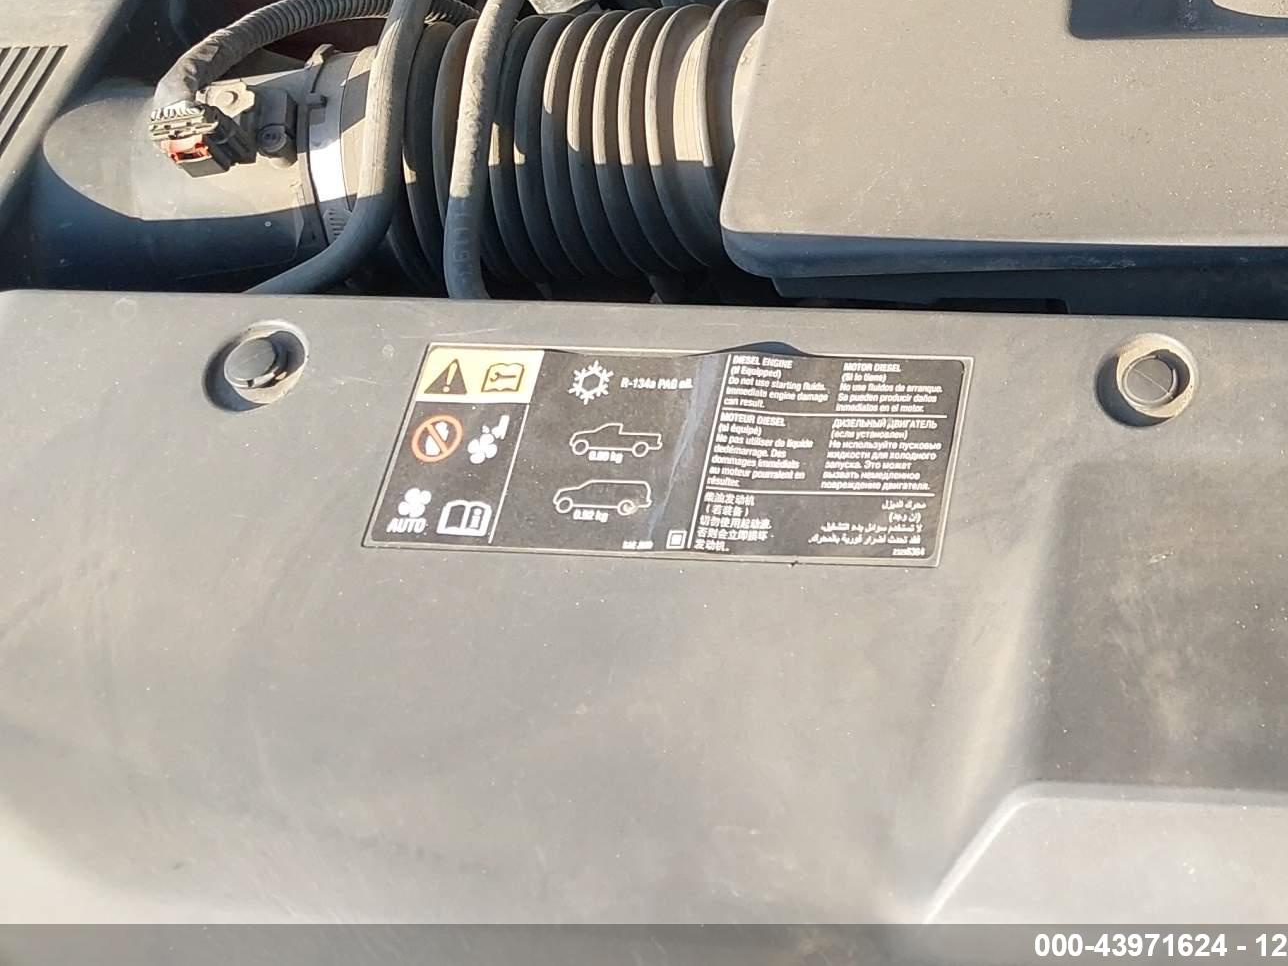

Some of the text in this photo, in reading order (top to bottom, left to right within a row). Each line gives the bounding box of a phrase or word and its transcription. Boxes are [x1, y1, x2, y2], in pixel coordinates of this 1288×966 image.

[733, 355, 793, 369] DIESEL ENGINE
[843, 362, 901, 372] MOTOR DIESEL
[741, 366, 782, 379] Equipped)
[620, 377, 656, 389] R-134a
[728, 376, 739, 384] Do
[771, 380, 801, 391] starting
[895, 383, 905, 392] de
[769, 391, 796, 401] engine
[797, 392, 828, 403] damage
[849, 394, 879, 403] pueden
[879, 394, 912, 403] producir
[720, 412, 786, 427] MOTEUR DIESEL
[832, 418, 937, 430] ДИЗЕЛЬНЫЙ ДВИГАТЕЛЬ
[716, 433, 728, 442] Ne
[728, 435, 744, 444] pas
[774, 438, 786, 447] de
[871, 452, 888, 460] для
[864, 460, 881, 469] Это
[709, 466, 720, 474] au
[721, 467, 751, 477] moteur
[386, 518, 427, 533] AUTO
